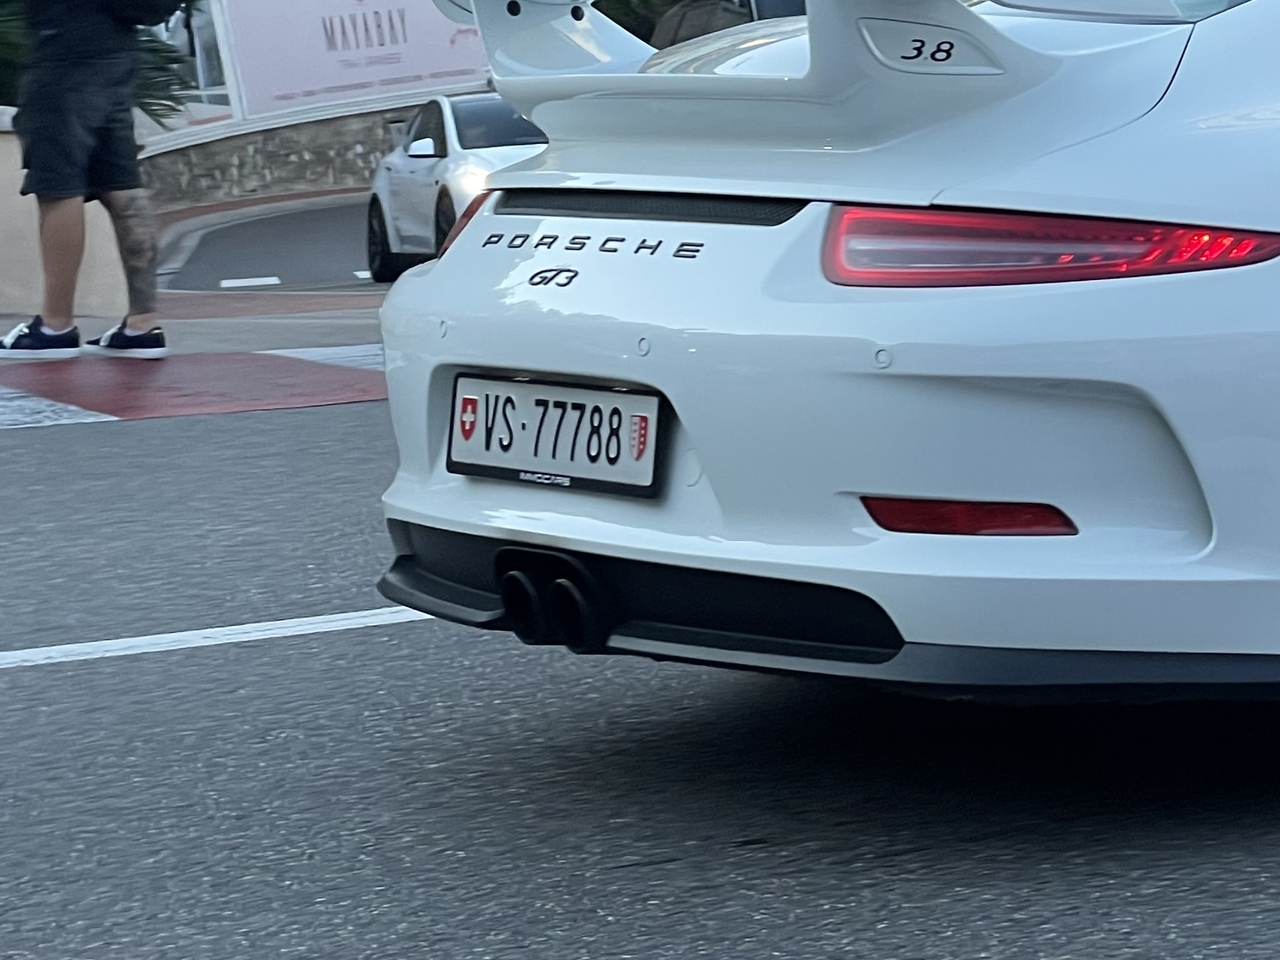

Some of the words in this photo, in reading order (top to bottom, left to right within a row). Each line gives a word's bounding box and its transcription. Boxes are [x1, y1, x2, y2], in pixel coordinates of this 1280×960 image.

[321, 7, 408, 52] MAYABAY
[482, 233, 705, 259] PORSCHE
[528, 268, 579, 288] GT3
